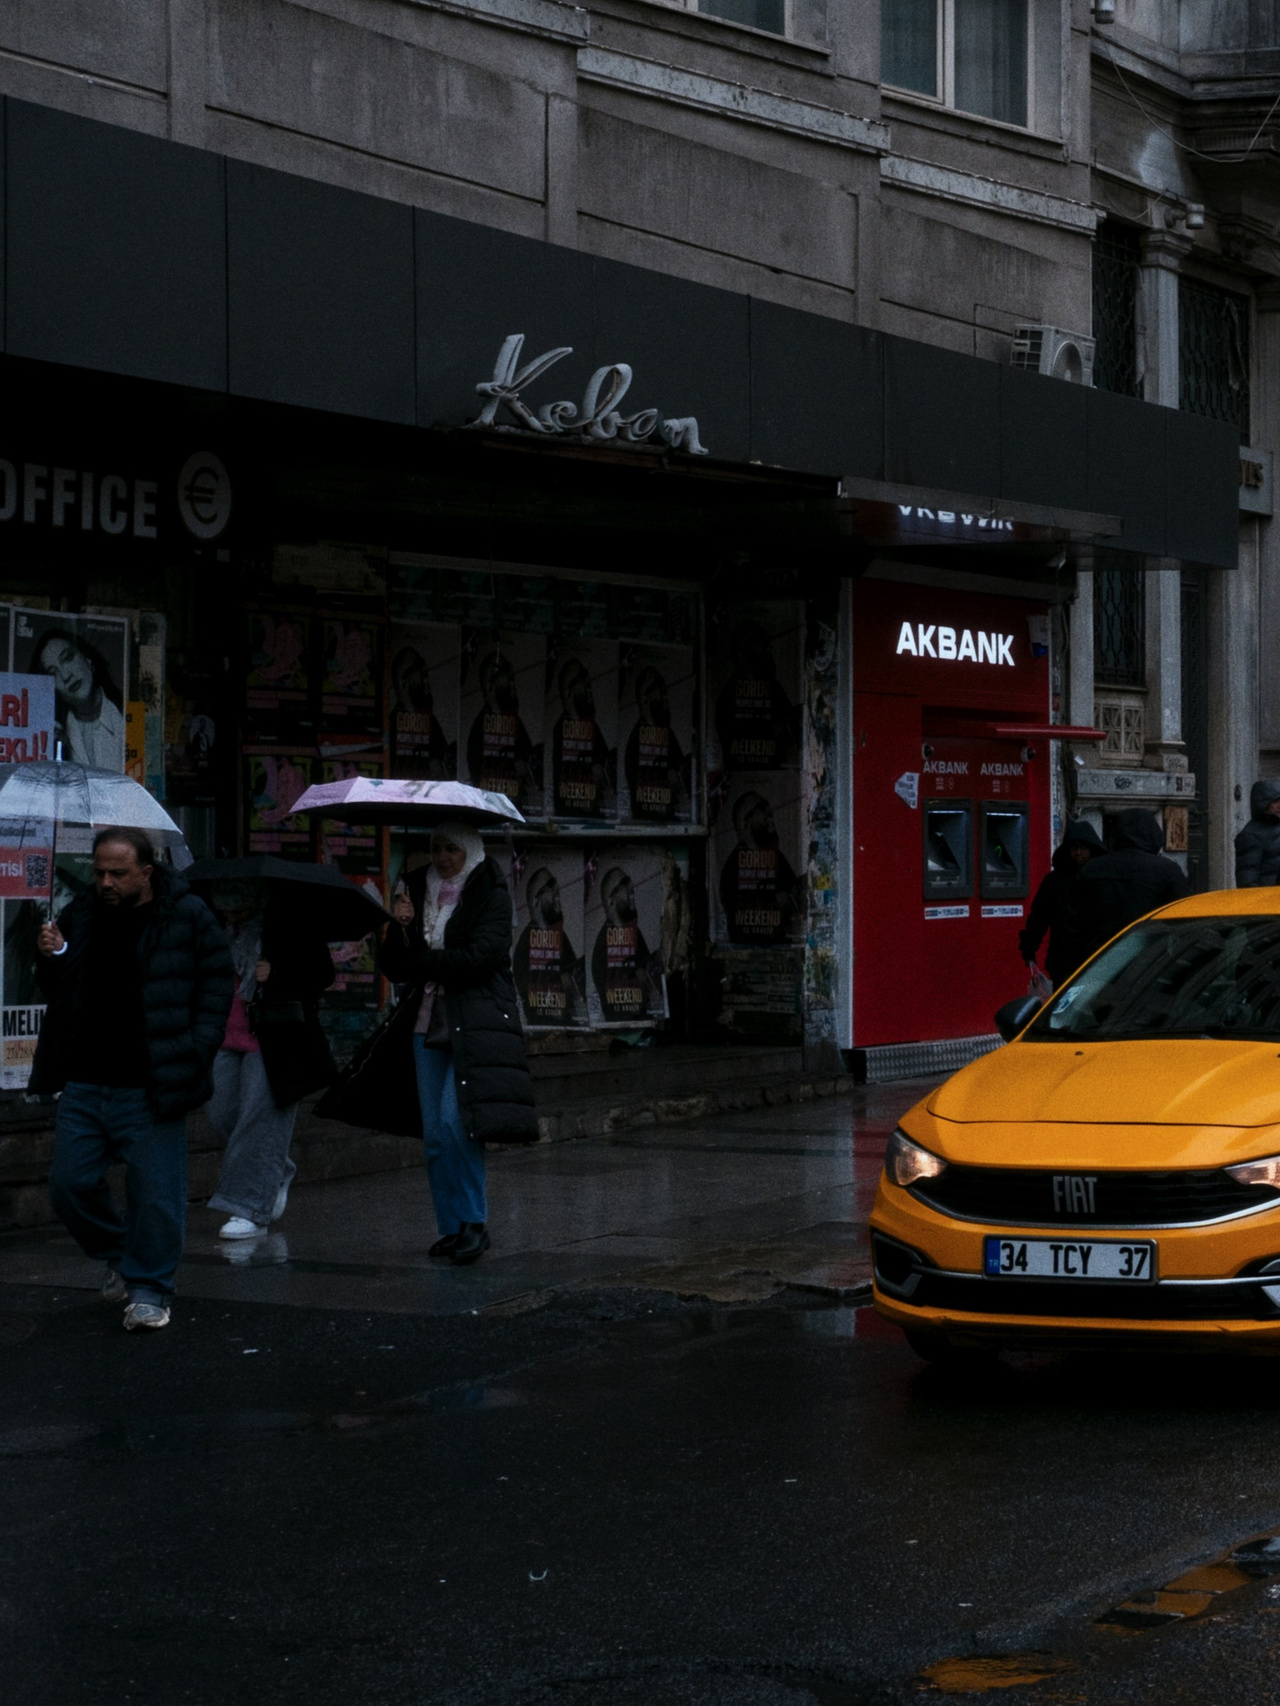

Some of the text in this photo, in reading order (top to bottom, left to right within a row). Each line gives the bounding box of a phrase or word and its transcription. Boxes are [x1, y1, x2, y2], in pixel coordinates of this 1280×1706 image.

[475, 333, 709, 456] Keban
[896, 621, 1016, 667] AKBANK
[922, 759, 969, 775] AKBANK
[980, 762, 1024, 776] AKBANK
[738, 850, 777, 869] GORDO
[735, 909, 780, 926] WEEKEND
[529, 928, 561, 949] GORDO
[606, 927, 636, 946] GORDO
[528, 990, 566, 1009] WEEKEND
[606, 987, 642, 1004] WEEKEND
[1052, 1175, 1098, 1214] FIAT
[988, 1242, 1149, 1277] TR 34 TCY 37
